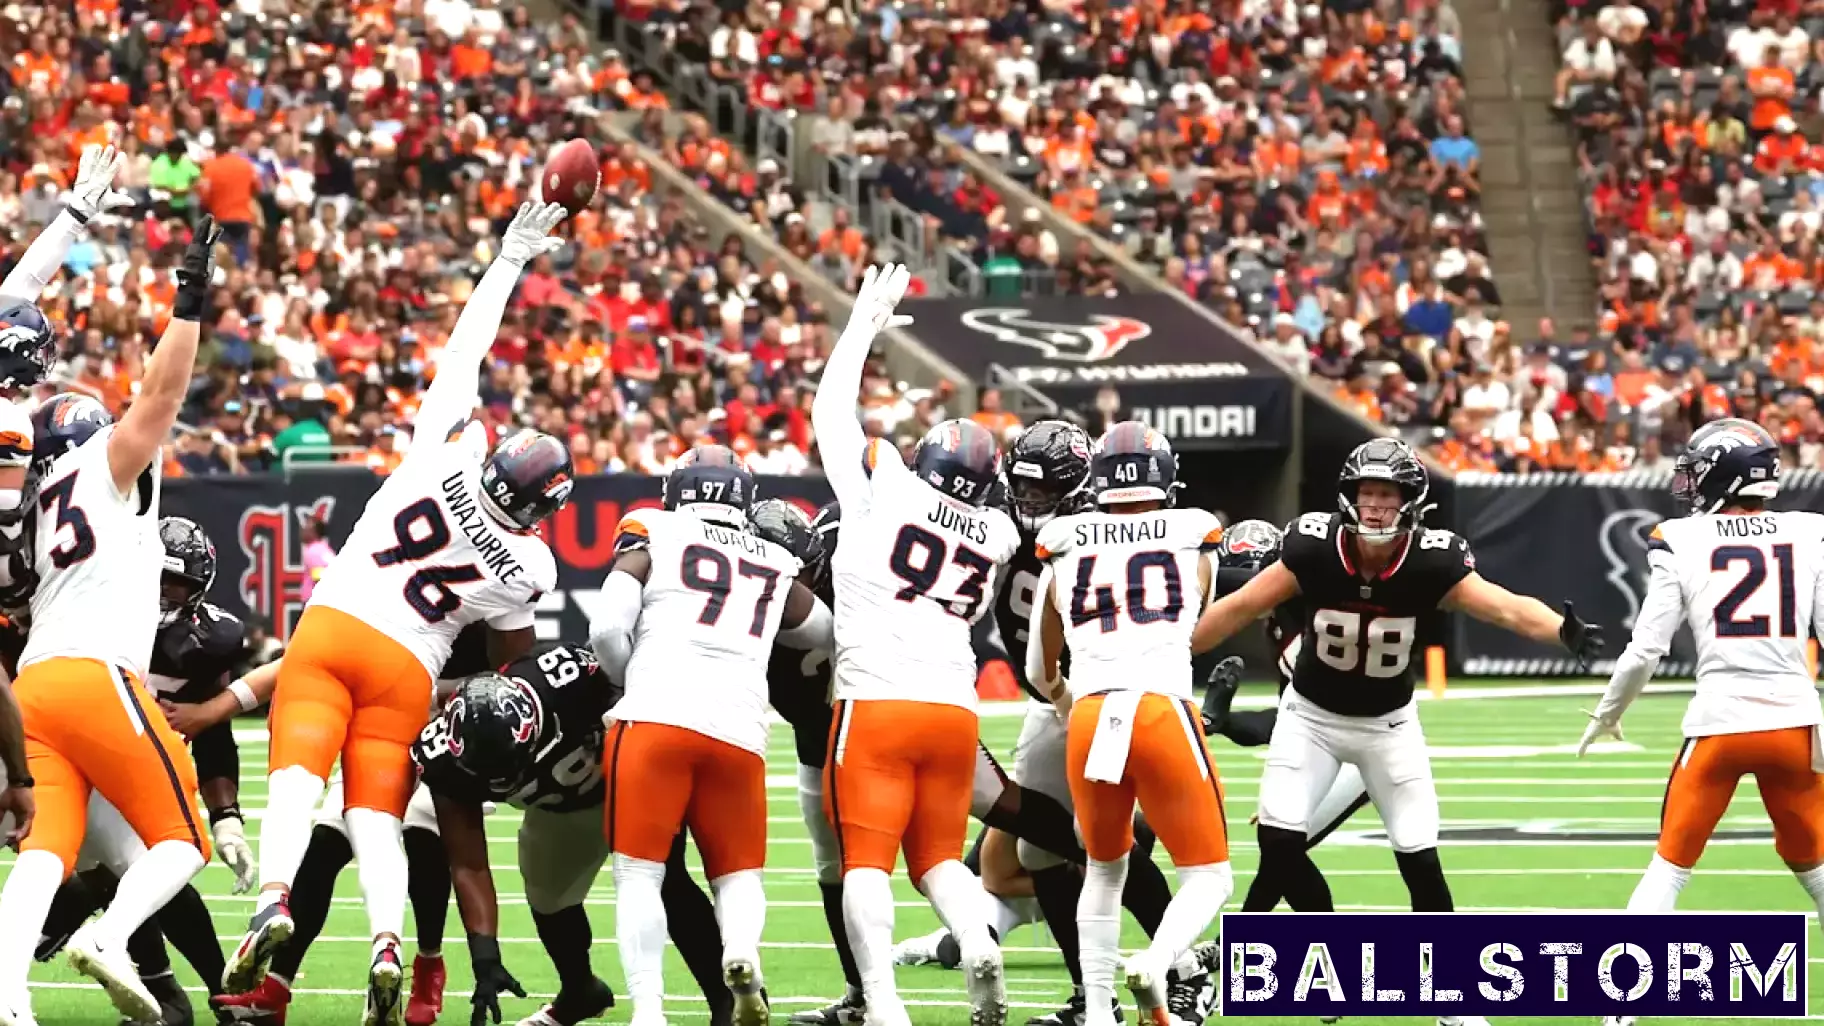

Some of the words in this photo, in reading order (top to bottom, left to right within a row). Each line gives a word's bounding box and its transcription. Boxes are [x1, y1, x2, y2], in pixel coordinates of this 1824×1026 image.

[493, 481, 515, 506] 96
[702, 481, 725, 501] 97
[951, 475, 977, 499] 93
[1114, 462, 1138, 483] 40
[441, 470, 524, 585] UWAZURIKE
[1075, 518, 1168, 547] STRNAD
[1716, 515, 1778, 538] MOSS
[370, 496, 487, 625] 96
[889, 522, 995, 627] 93
[680, 543, 783, 639] 97
[1068, 550, 1185, 634] 40
[1709, 542, 1798, 640] 21
[536, 645, 581, 689] 69
[1313, 608, 1417, 679] 88
